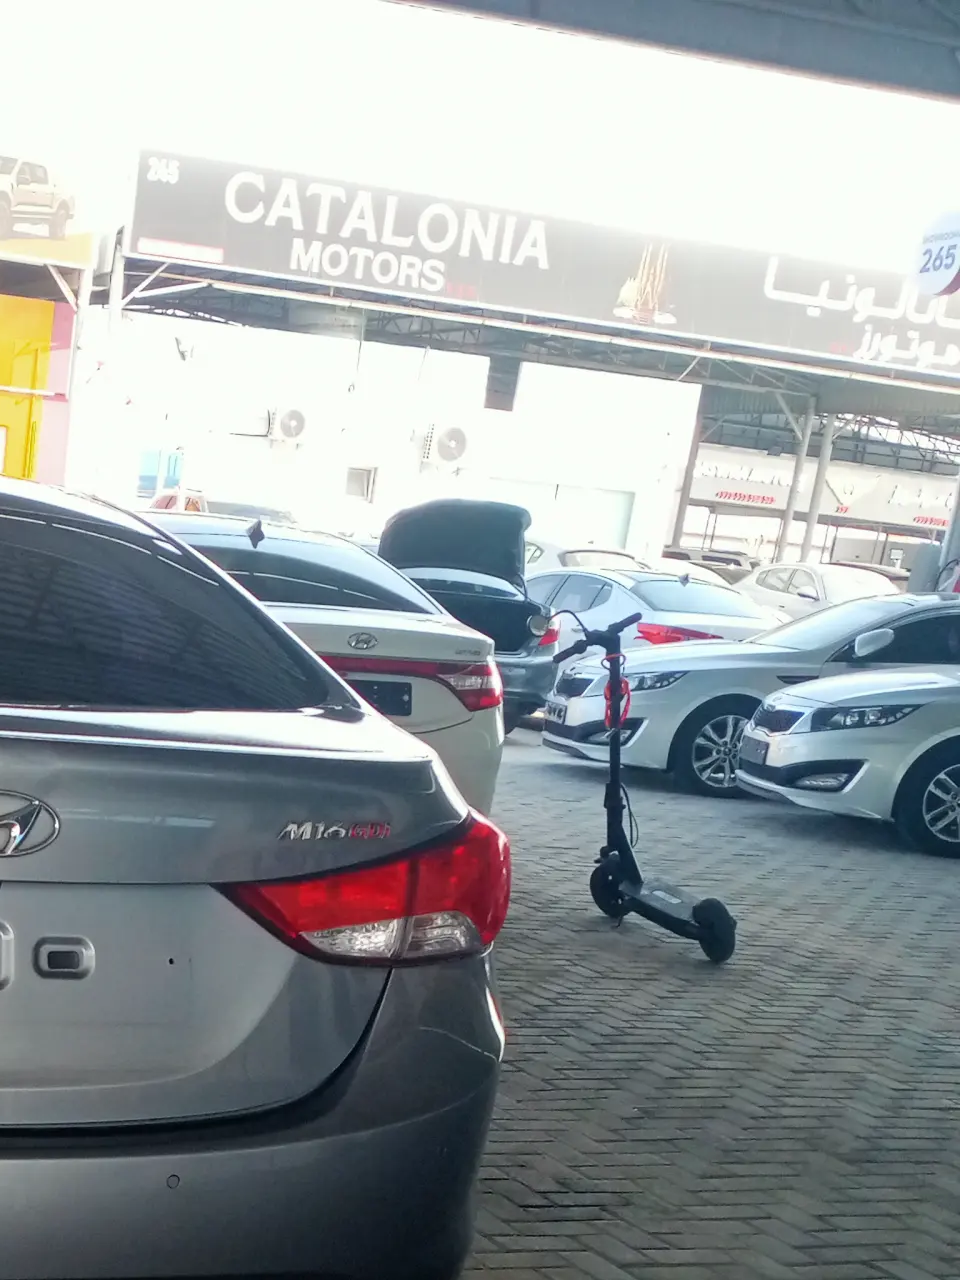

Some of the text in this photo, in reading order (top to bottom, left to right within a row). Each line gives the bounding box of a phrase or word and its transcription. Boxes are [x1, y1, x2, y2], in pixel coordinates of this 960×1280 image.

[224, 171, 550, 270] CATALONIA
[289, 237, 447, 292] MOTORS
[919, 244, 958, 273] 265
